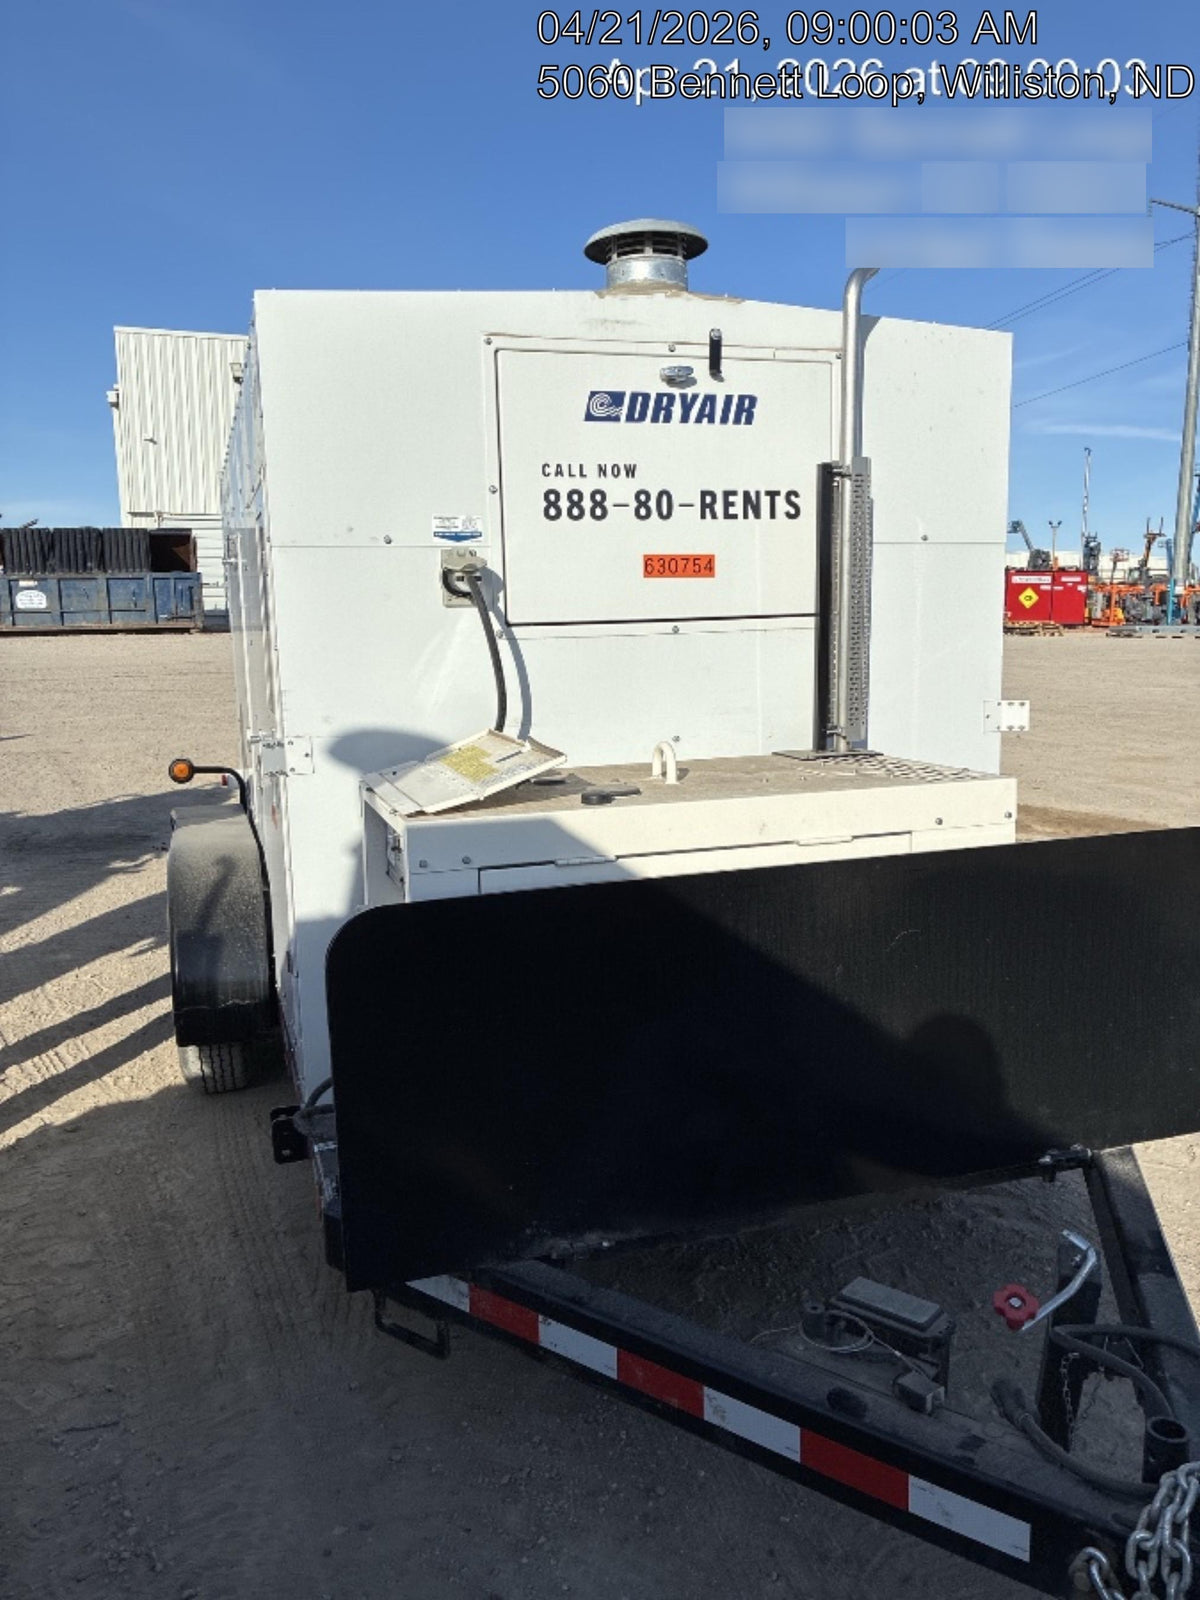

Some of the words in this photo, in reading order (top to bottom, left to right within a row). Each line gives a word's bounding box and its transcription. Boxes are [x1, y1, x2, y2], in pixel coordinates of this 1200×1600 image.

[625, 391, 758, 426] DRYAIR
[541, 463, 587, 478] CALL
[597, 463, 637, 478] NOW
[543, 488, 801, 522] 888-80-RENTS
[644, 557, 713, 575] 630754
